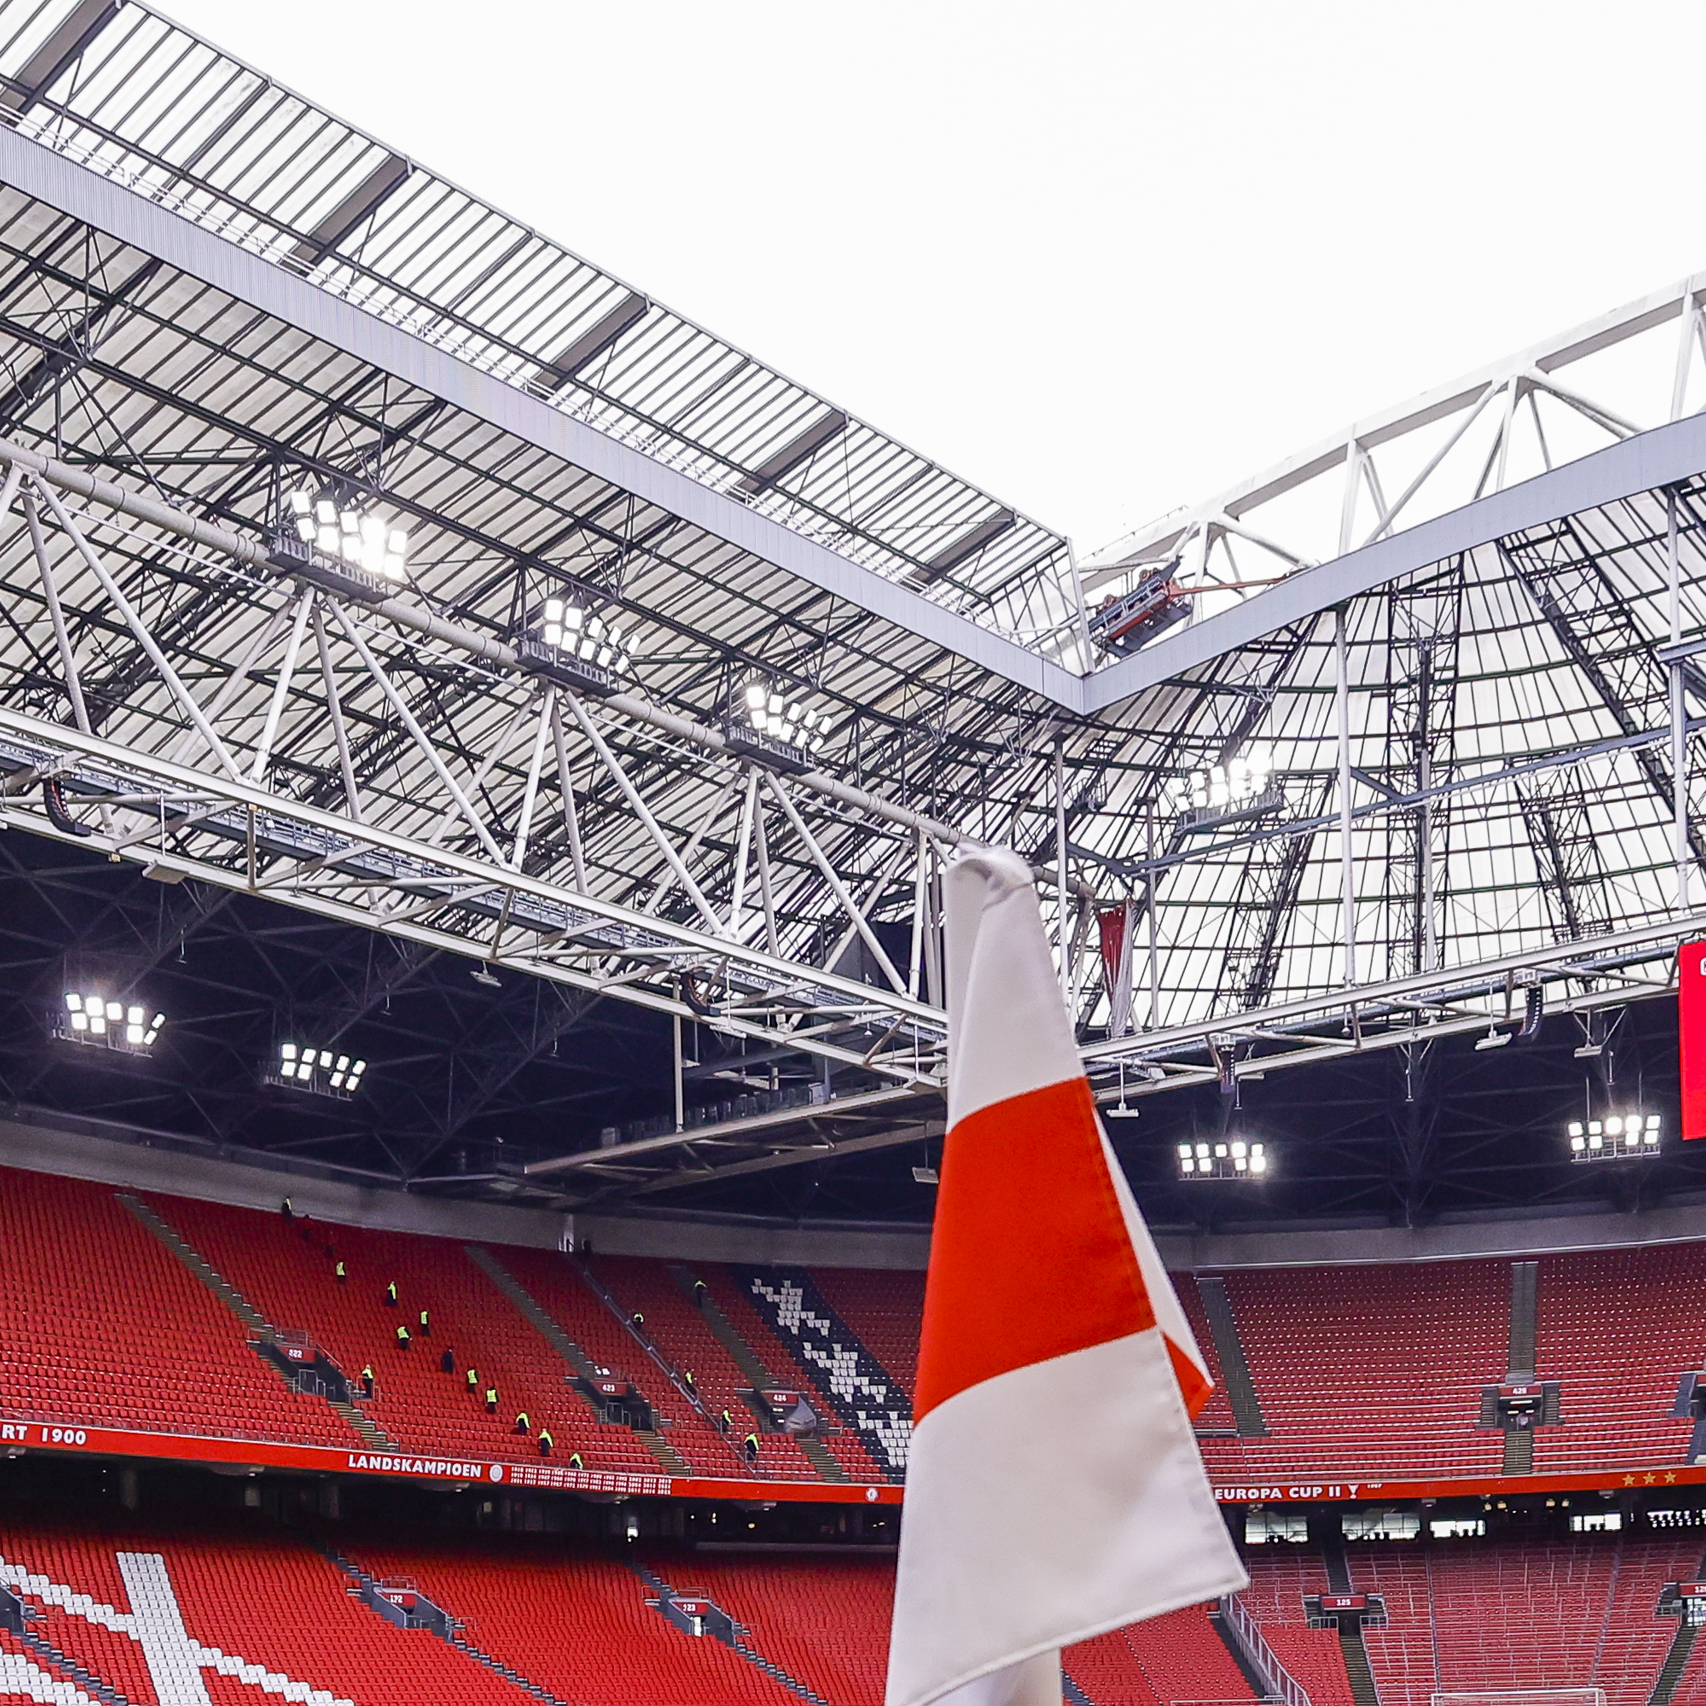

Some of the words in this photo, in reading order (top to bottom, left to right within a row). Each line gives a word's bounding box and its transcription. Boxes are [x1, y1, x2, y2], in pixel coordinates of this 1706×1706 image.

[41, 1427, 86, 1446] 1900
[348, 1454, 481, 1478] LANDSKAMPIOEN
[1214, 1487, 1282, 1500] EUROPA
[1288, 1486, 1323, 1499] CUP
